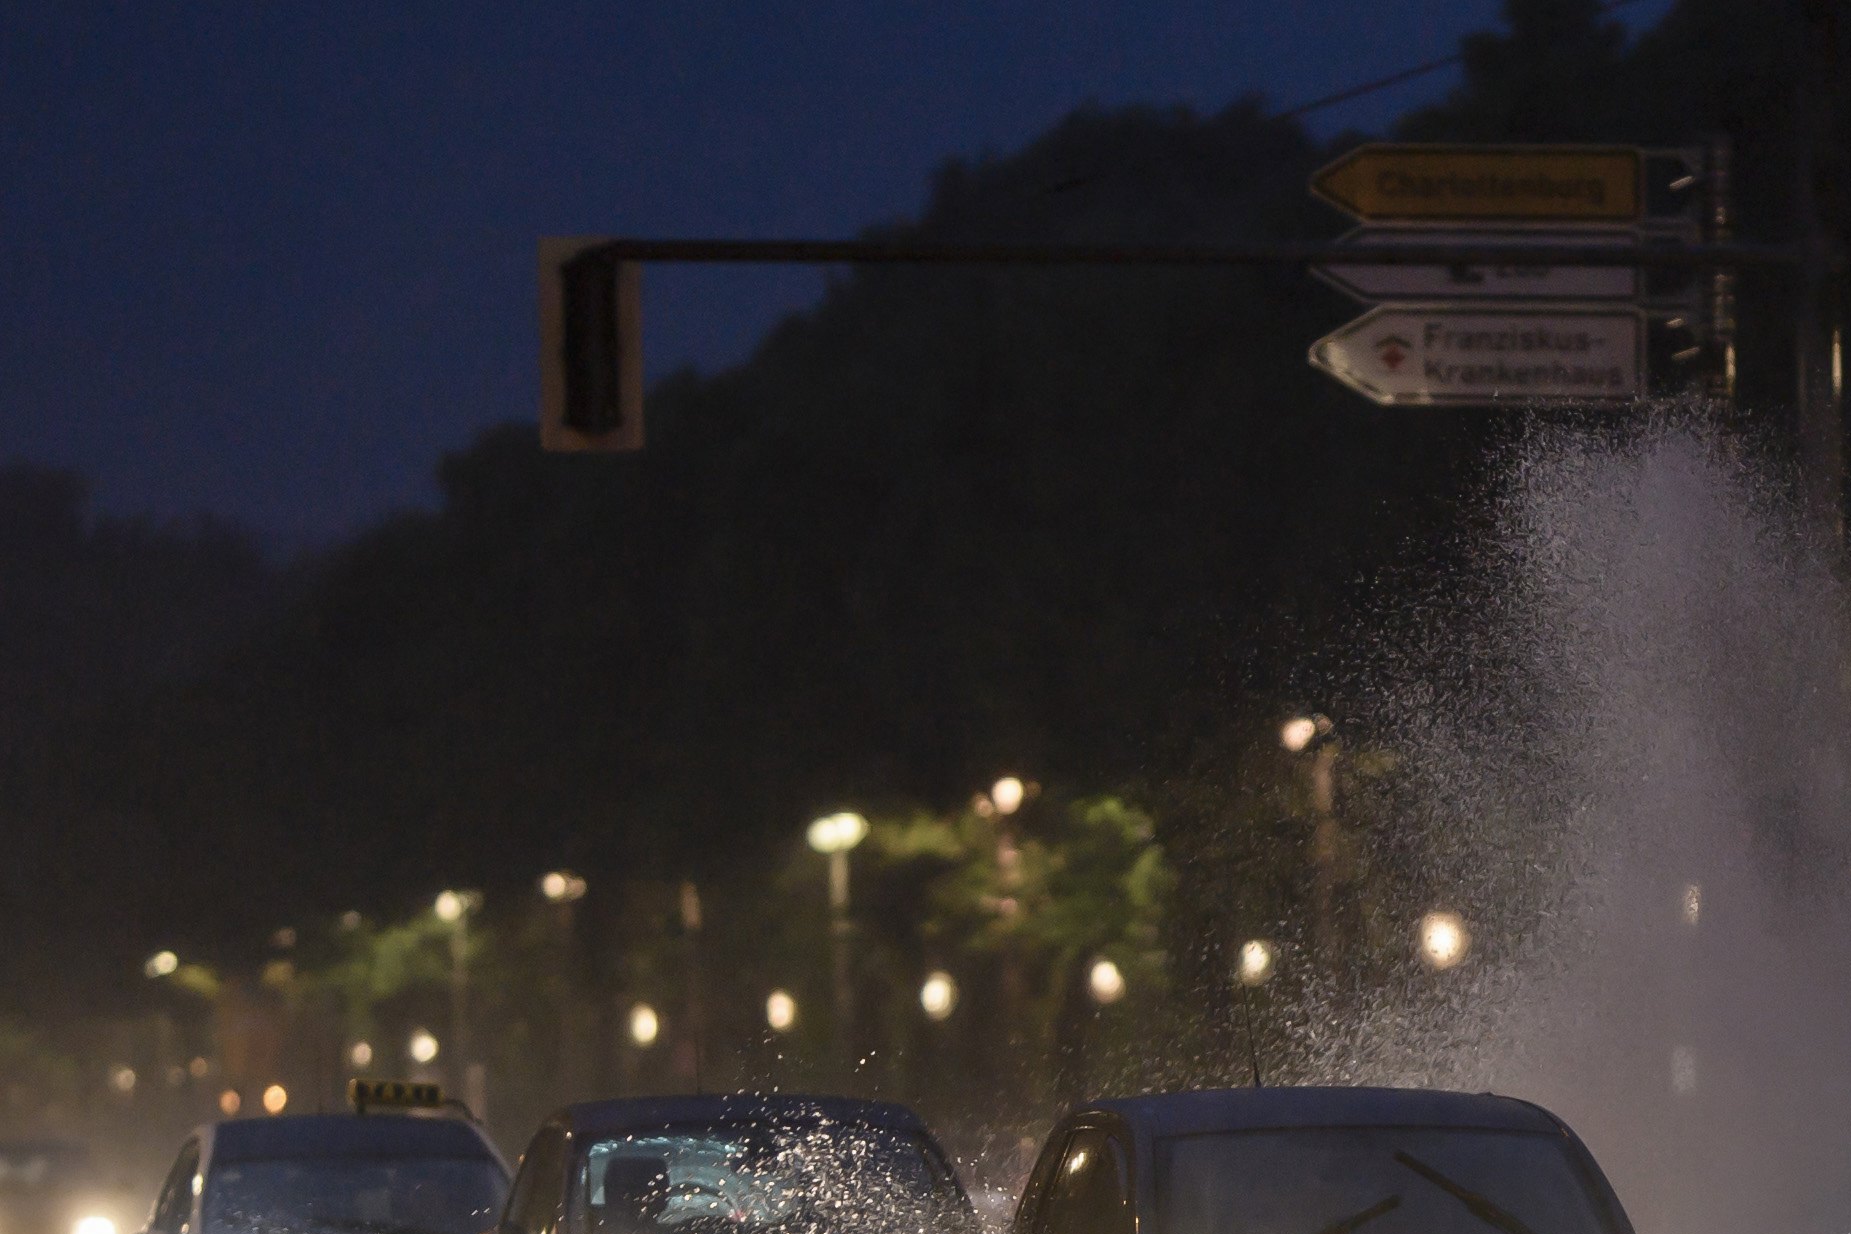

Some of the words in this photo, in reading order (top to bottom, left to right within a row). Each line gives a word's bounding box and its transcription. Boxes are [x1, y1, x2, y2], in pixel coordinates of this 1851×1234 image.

[1377, 170, 1605, 204] Charlottenburg
[1423, 322, 1606, 351] Franziskus-
[1424, 359, 1623, 388] Krankenhaus
